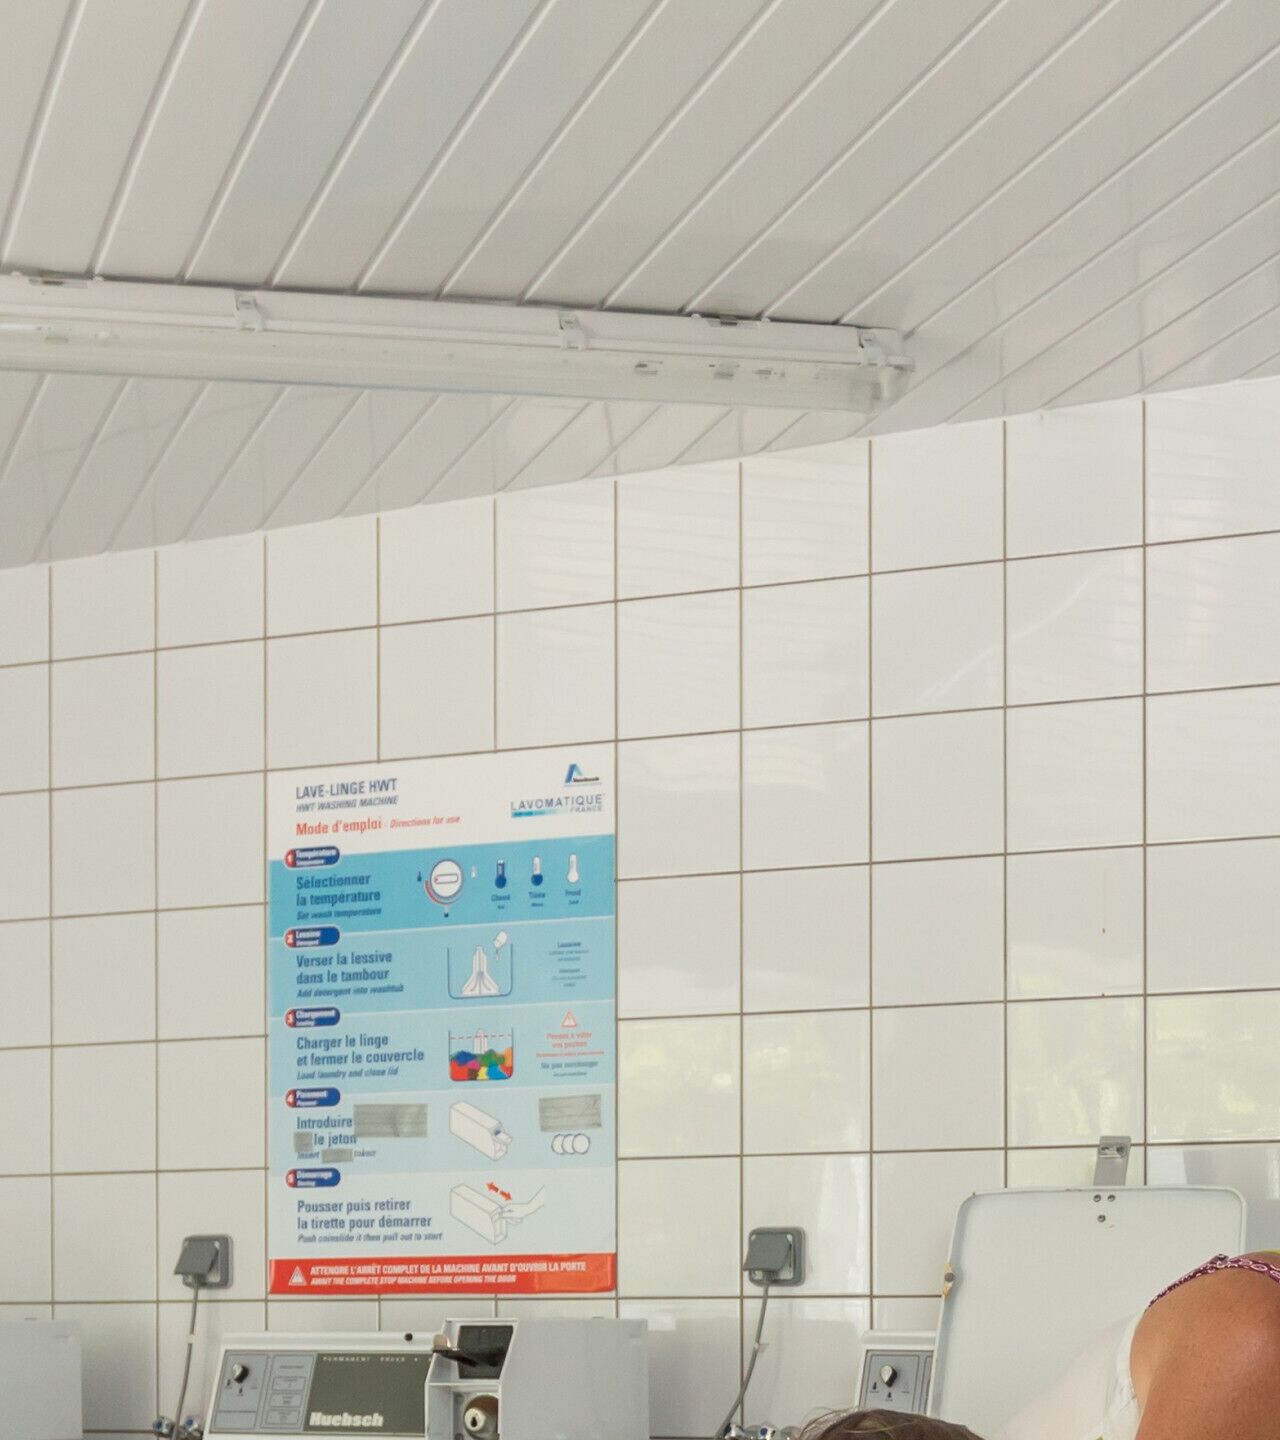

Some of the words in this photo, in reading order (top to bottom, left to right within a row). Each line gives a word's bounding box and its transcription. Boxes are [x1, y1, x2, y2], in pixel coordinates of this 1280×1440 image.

[296, 780, 364, 800] LAVE-LINGE
[368, 777, 397, 793] HWT
[510, 793, 602, 811] LAVOMATIQUE
[296, 821, 328, 835] Mode
[331, 816, 382, 834] d'emploi
[296, 874, 371, 890] Sélectionner
[296, 893, 307, 906] la
[309, 890, 381, 907] température
[296, 954, 334, 968] Verser
[336, 952, 347, 965] la
[350, 950, 392, 965] lessive
[296, 971, 323, 985] dans
[326, 969, 338, 983] le
[340, 967, 390, 982] tambour
[296, 1036, 341, 1051] Charger
[345, 1034, 356, 1047] le
[359, 1033, 389, 1049] linge
[296, 1055, 308, 1066] et
[310, 1052, 348, 1066] fermer
[351, 1051, 362, 1064] le
[365, 1048, 424, 1063] couvercle
[296, 1114, 353, 1129] Introduire
[314, 1133, 325, 1145] le
[328, 1131, 357, 1148] jeton
[297, 1199, 343, 1213] Pousser
[346, 1198, 371, 1216] puis
[374, 1197, 411, 1211] retirer
[297, 1216, 308, 1229] la
[310, 1217, 345, 1229] tirette
[348, 1218, 375, 1232] pour
[378, 1215, 432, 1228] démarrer
[431, 1264, 442, 1273] LA
[481, 1262, 508, 1272] AVANT
[548, 1262, 559, 1271] LA
[560, 1261, 586, 1271] PORTE
[309, 1411, 385, 1428] Huebsch
